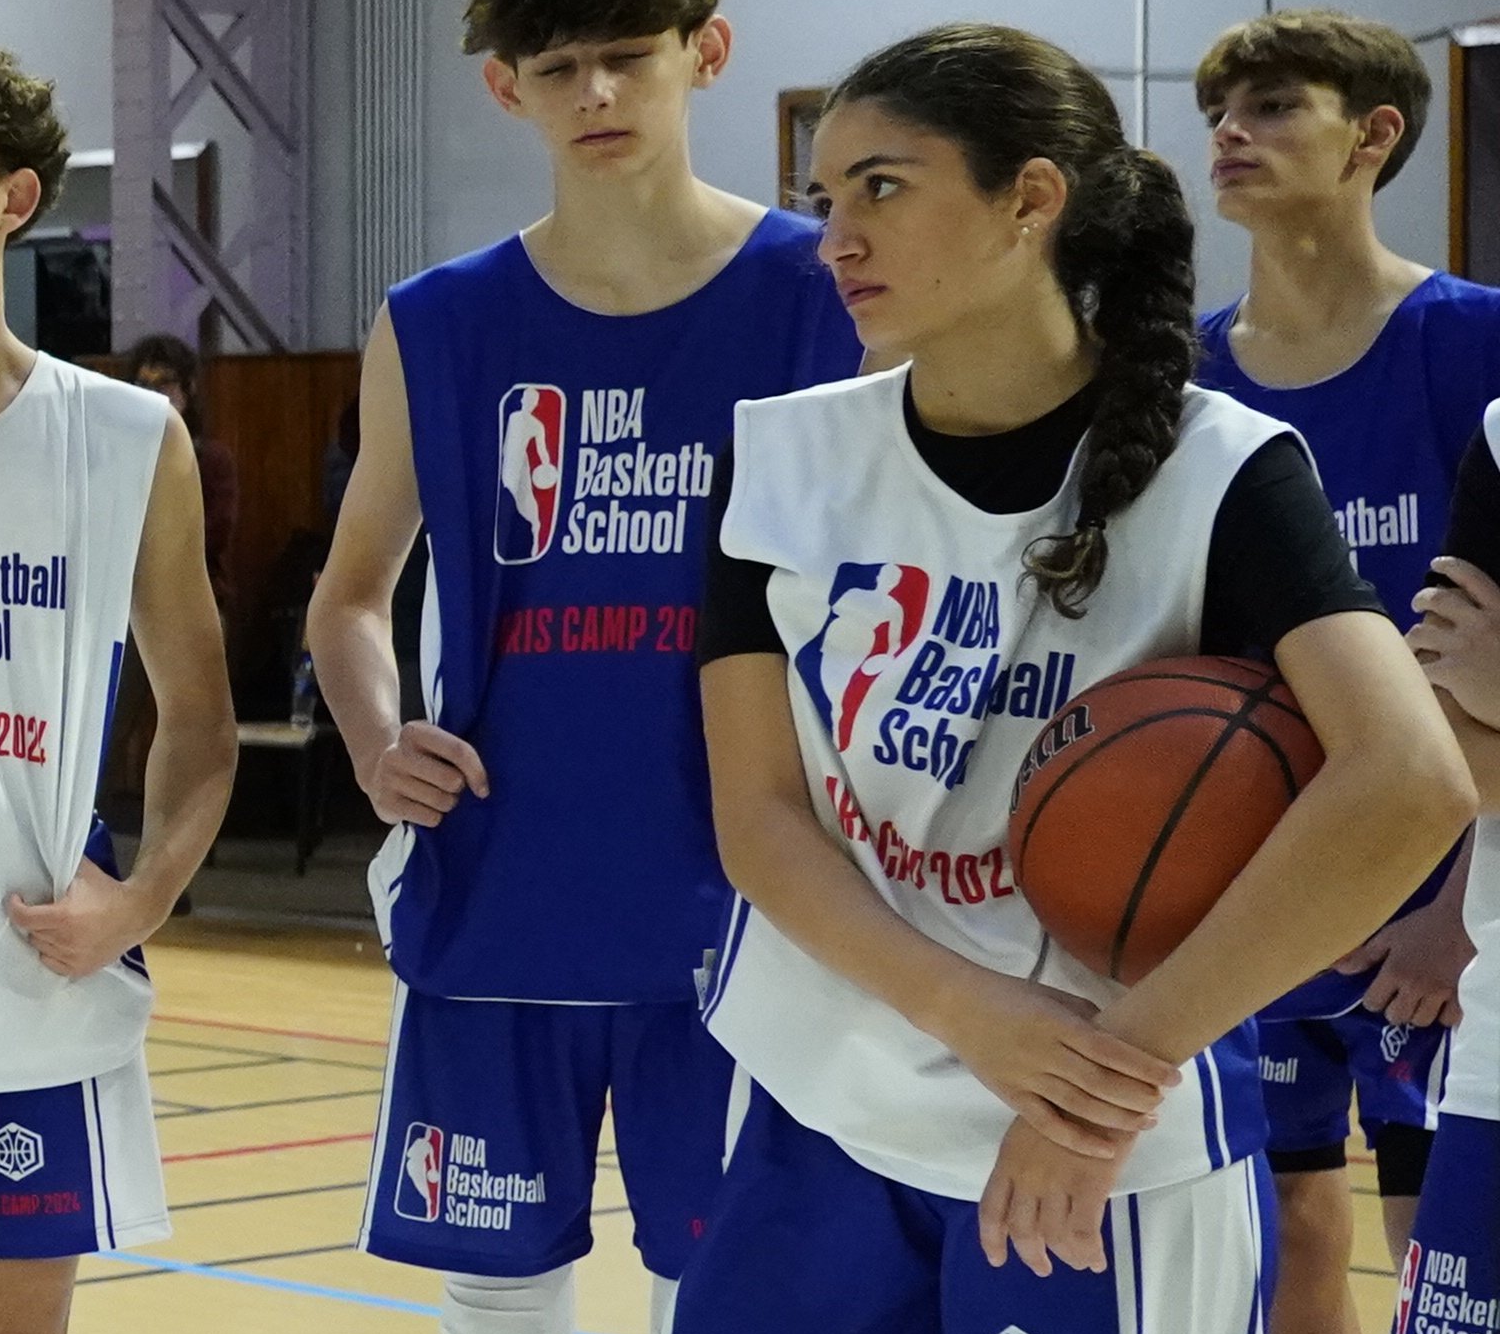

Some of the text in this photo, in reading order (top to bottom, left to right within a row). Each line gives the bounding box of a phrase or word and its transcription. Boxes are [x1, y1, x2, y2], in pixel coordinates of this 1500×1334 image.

[580, 387, 645, 443] NBA
[574, 442, 714, 500] Basketb
[562, 500, 687, 555] School
[561, 606, 648, 652] CAMP
[655, 606, 696, 652] 20
[931, 575, 1000, 649] NBA
[930, 847, 1019, 905] 202
[450, 1133, 485, 1168] NBA
[446, 1164, 546, 1203] Basketball
[445, 1195, 512, 1231] School
[1424, 1249, 1467, 1289] NBA
[1418, 1282, 1500, 1328] Basket
